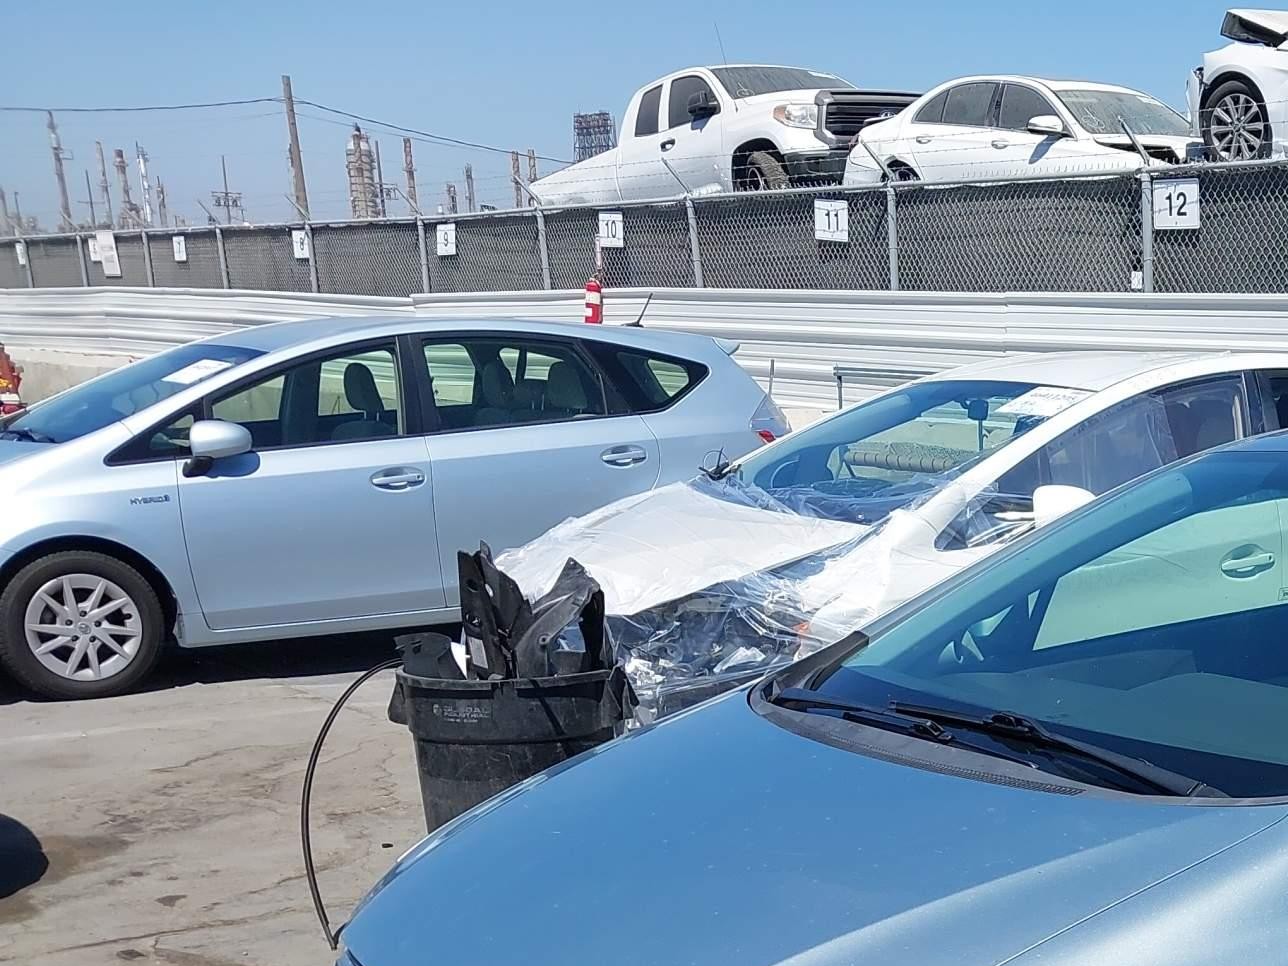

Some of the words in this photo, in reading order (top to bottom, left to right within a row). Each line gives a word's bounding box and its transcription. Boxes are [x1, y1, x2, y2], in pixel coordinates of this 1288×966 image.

[1165, 192, 1187, 216] 12
[605, 220, 617, 239] 10
[825, 210, 839, 231] 11
[443, 231, 449, 248] 9
